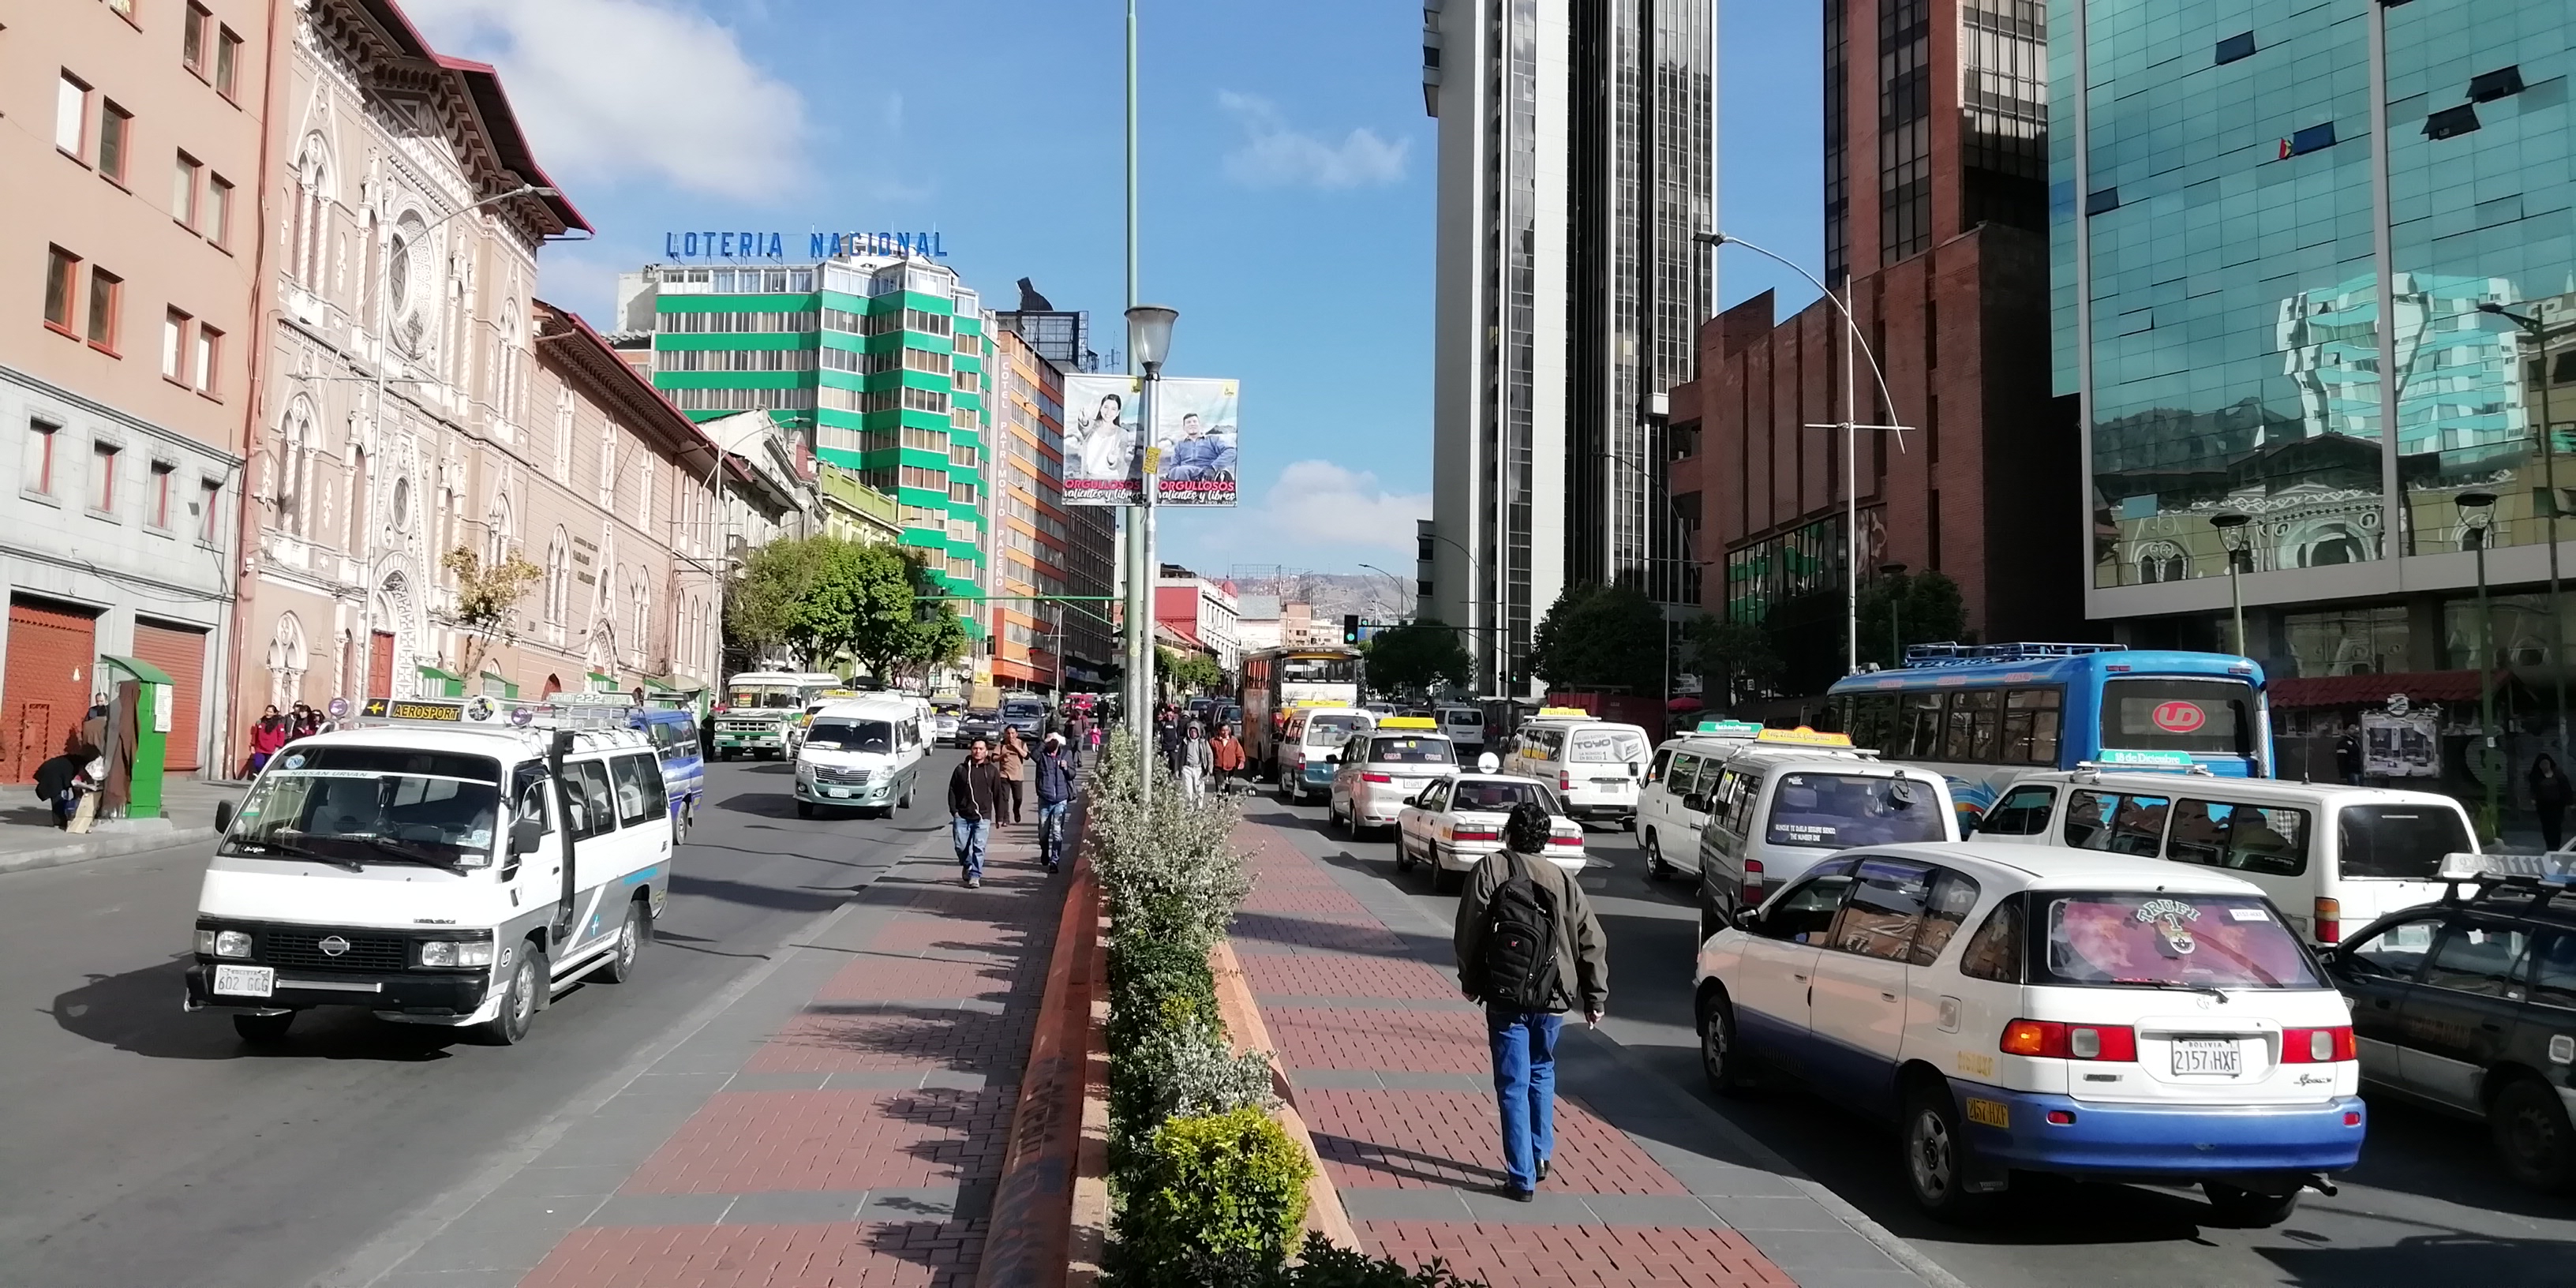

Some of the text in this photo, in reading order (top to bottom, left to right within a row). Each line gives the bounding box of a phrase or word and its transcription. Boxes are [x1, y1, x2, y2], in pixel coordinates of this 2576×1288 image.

[666, 231, 948, 257] LOTERIA NACIONAL
[998, 421, 1008, 517] PATRIMONIO
[1065, 479, 1140, 489] ORGULLOSOS
[1159, 481, 1235, 492] ORGULLOSOS
[1064, 489, 1141, 501] valientes y libres
[1159, 489, 1236, 503] valientes y libres
[995, 530, 1005, 586] PACEÑO
[575, 695, 603, 703] 222
[393, 705, 459, 721] AEROSPORT
[2159, 707, 2200, 726] UD
[1574, 739, 1612, 750] TOYO
[1603, 751, 1608, 761] 1
[2126, 752, 2137, 762] de
[2136, 899, 2201, 923] TRUFI
[2165, 914, 2183, 931] 1
[219, 975, 240, 990] 602
[2175, 1050, 2238, 1070] 2157 HXF
